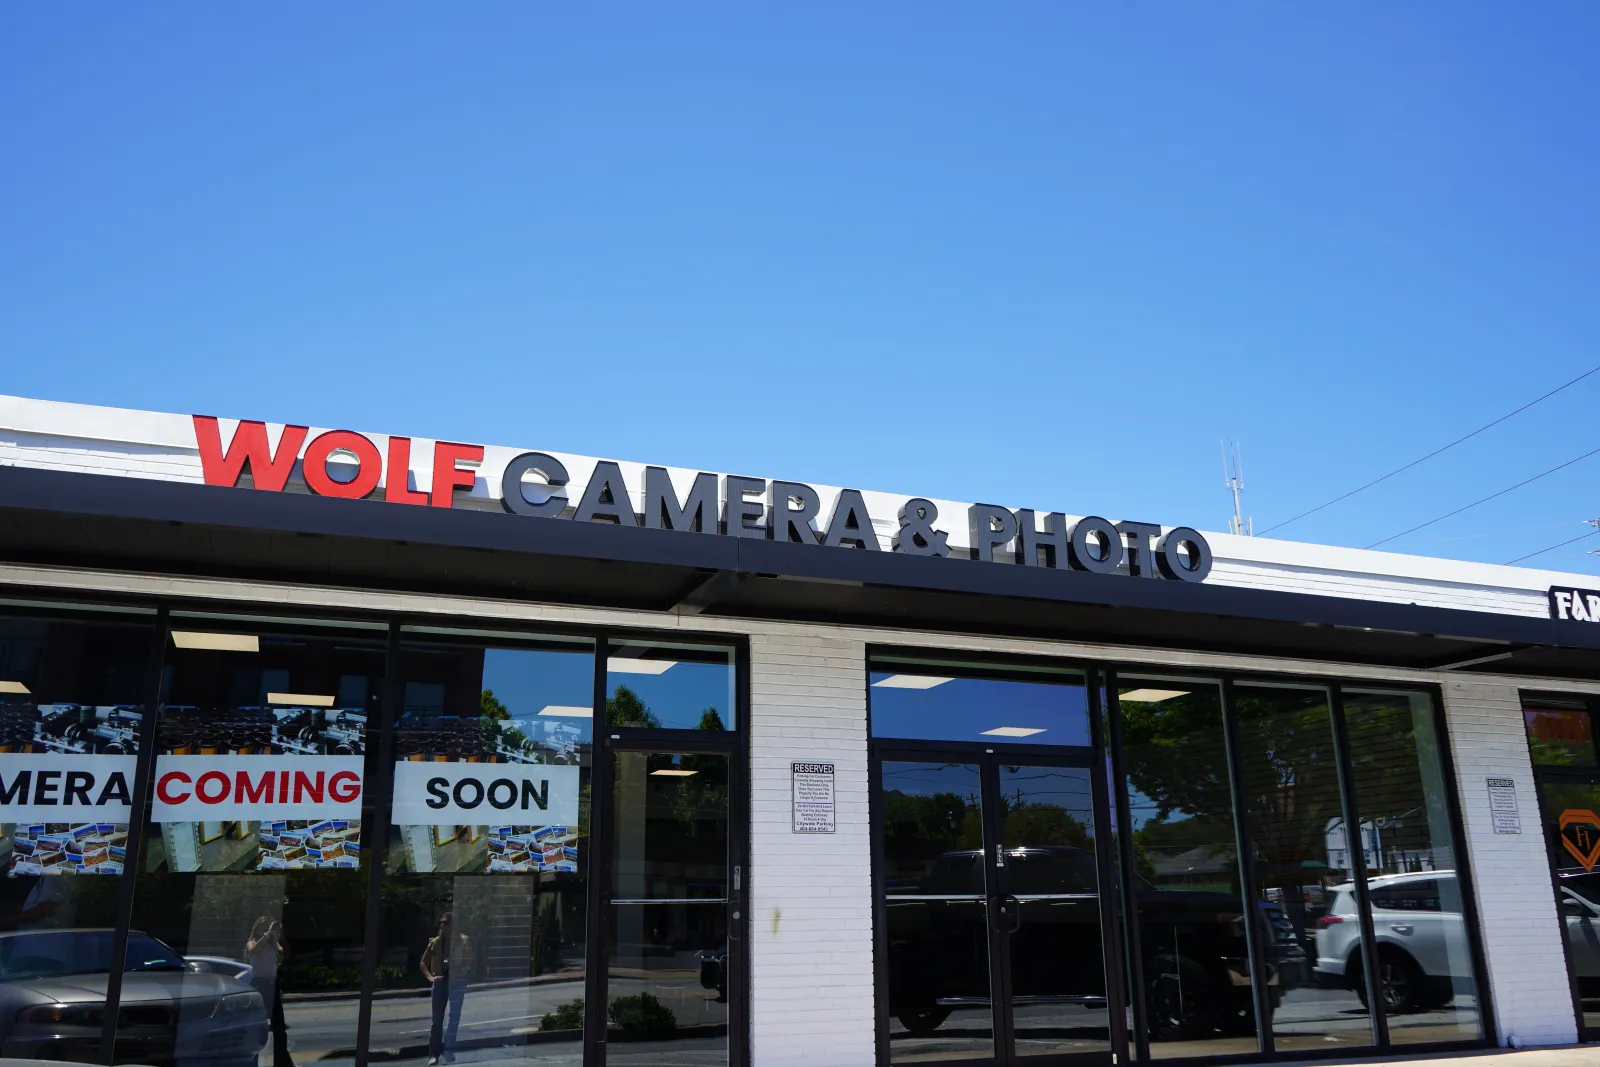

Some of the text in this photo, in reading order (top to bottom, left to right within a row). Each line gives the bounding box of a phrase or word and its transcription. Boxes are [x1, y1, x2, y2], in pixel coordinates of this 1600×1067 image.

[192, 414, 1213, 583] WOLF CAMERA & PHOTO
[794, 764, 834, 773] RESERVED
[156, 770, 361, 805] COMING
[425, 777, 549, 810] SOON
